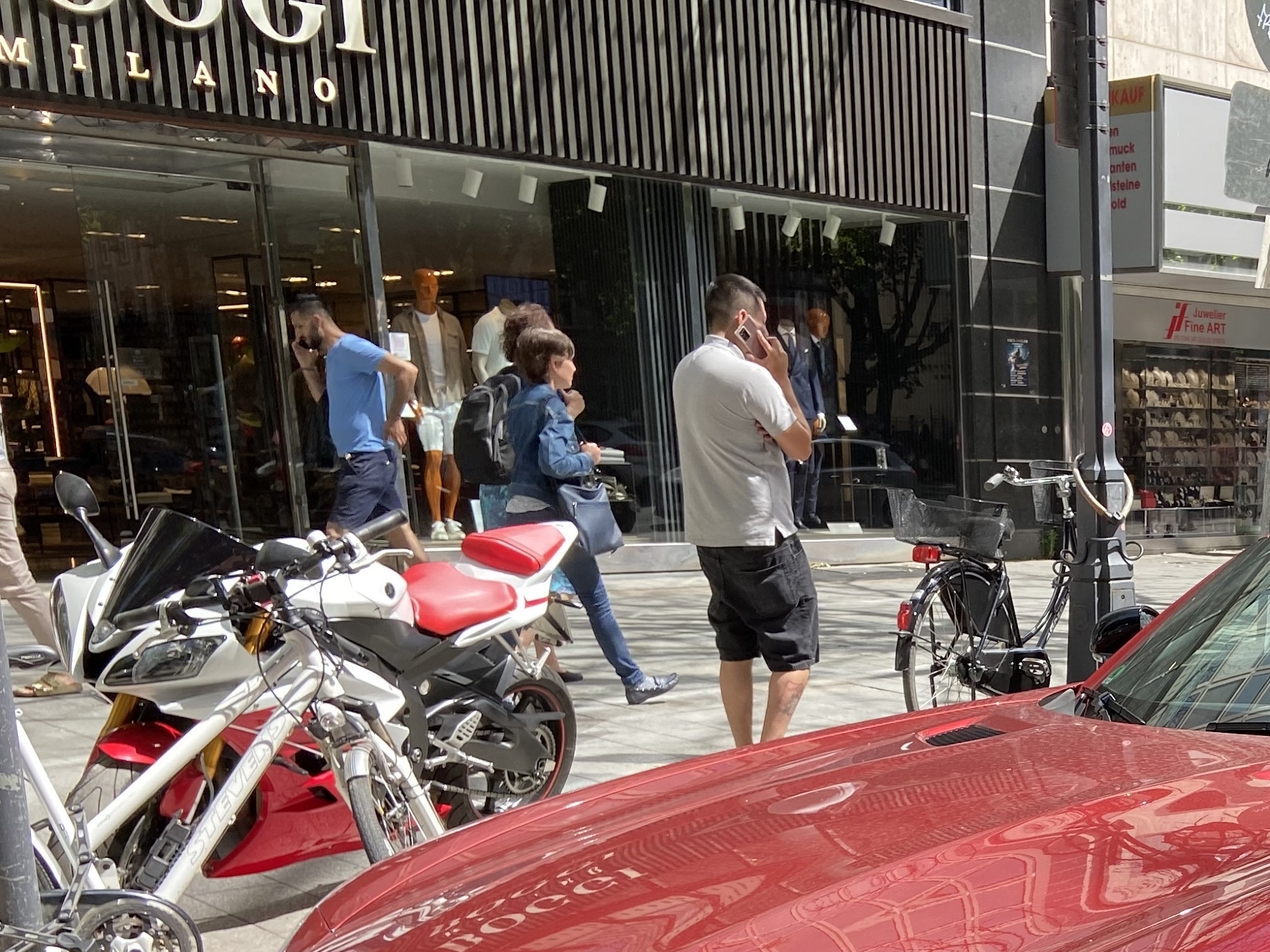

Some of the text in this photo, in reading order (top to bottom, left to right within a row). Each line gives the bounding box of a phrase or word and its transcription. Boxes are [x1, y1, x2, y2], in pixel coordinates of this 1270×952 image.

[0, 35, 337, 102] MILANO
[1110, 86, 1145, 105] KAUF
[1109, 127, 1119, 138] en
[1109, 142, 1135, 156] muck
[1110, 161, 1137, 174] anten
[1111, 179, 1141, 191] steine
[1111, 198, 1127, 209] old
[1193, 308, 1226, 320] Juwelier
[1184, 320, 1227, 335] Fine ART
[187, 715, 287, 866] STEVENS
